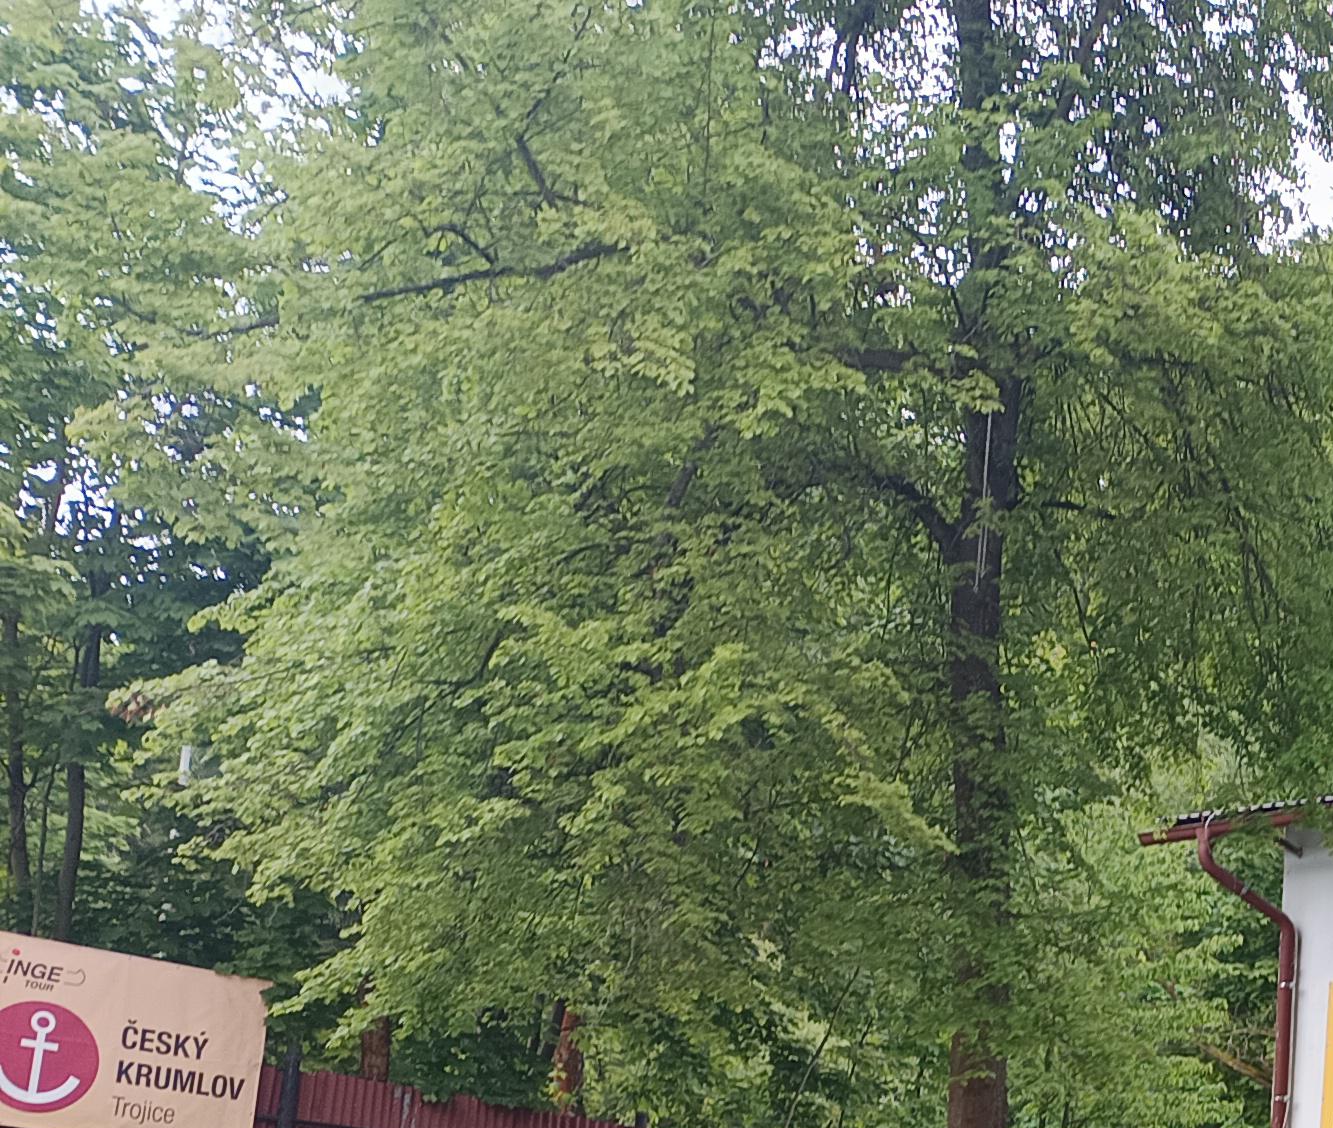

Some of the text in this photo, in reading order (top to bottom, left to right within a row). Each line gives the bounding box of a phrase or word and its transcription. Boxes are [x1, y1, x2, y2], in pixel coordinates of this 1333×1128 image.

[121, 1019, 209, 1060] ČESKÝ
[115, 1060, 246, 1100] KRUMLOV
[112, 1095, 176, 1125] Trojice
